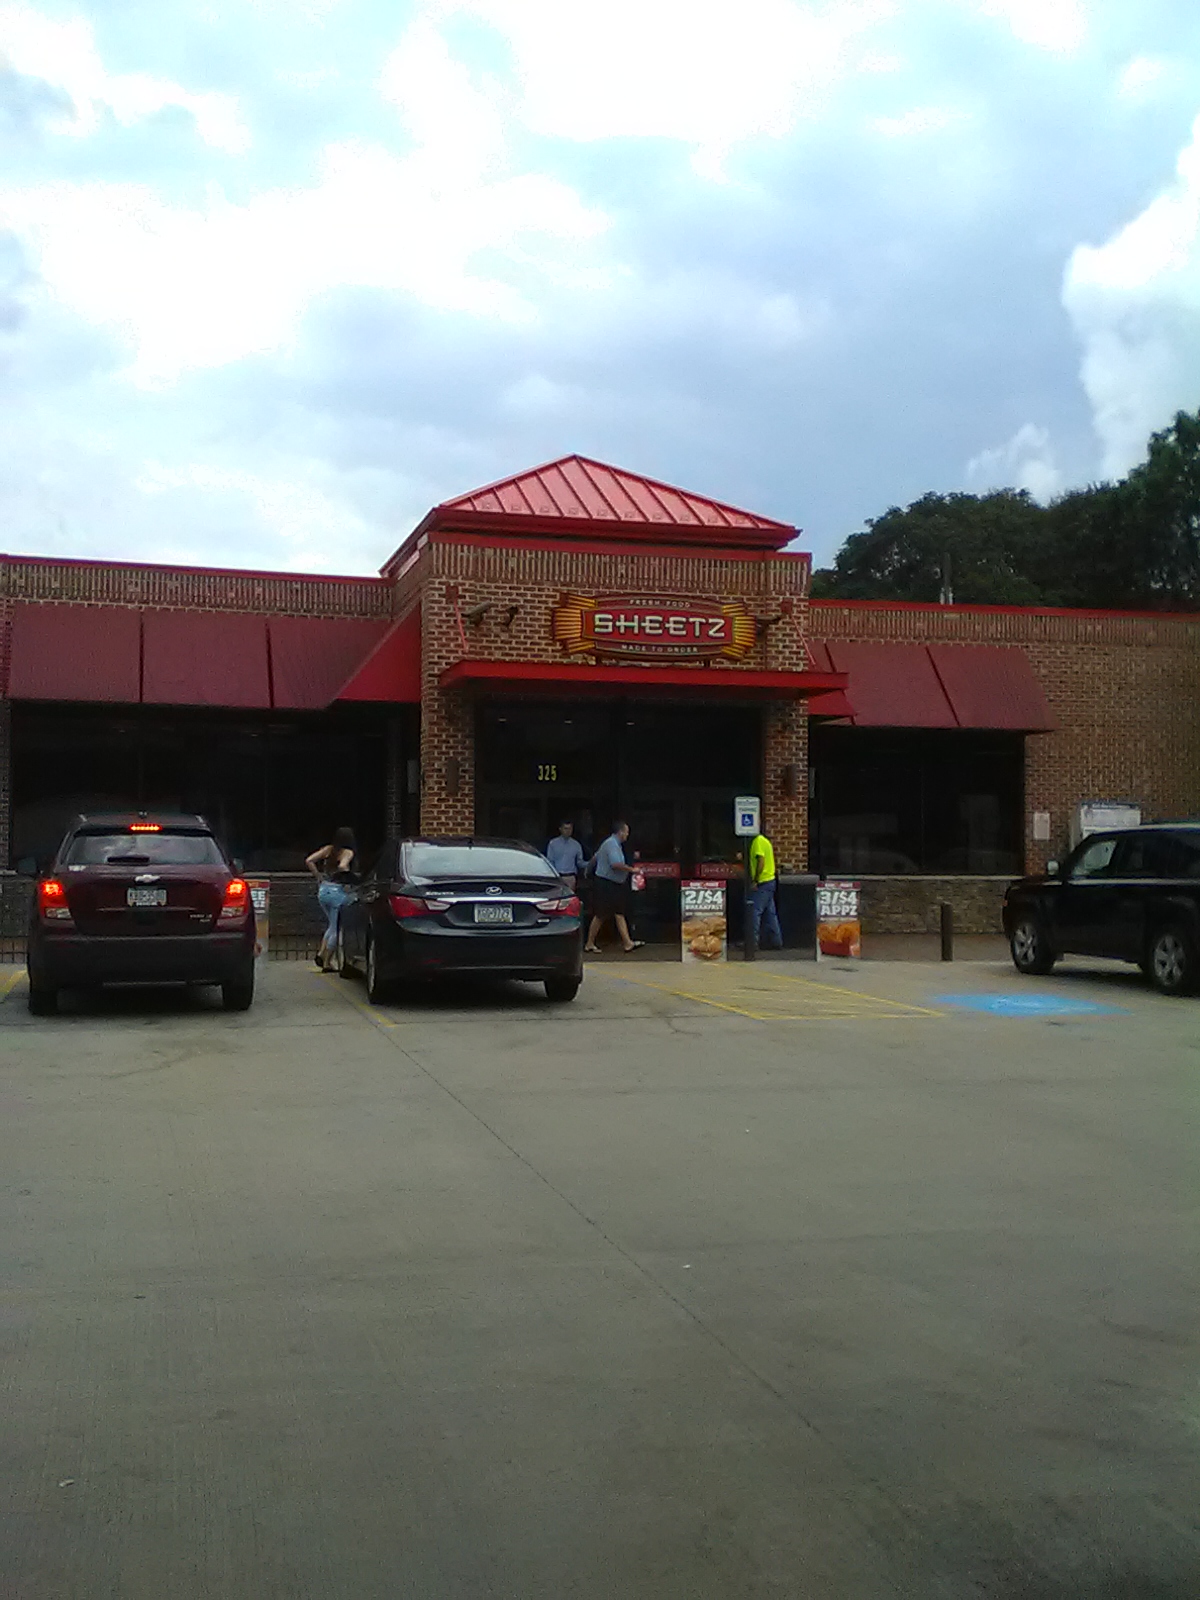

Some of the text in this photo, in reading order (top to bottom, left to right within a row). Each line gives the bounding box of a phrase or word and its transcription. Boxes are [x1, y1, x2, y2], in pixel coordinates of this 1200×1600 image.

[594, 613, 725, 638] SHEETZ
[621, 644, 646, 652] MADE
[538, 764, 558, 782] 325
[685, 890, 723, 904] 2/$4
[820, 890, 858, 904] 3/$4
[820, 905, 858, 916] APPZ
